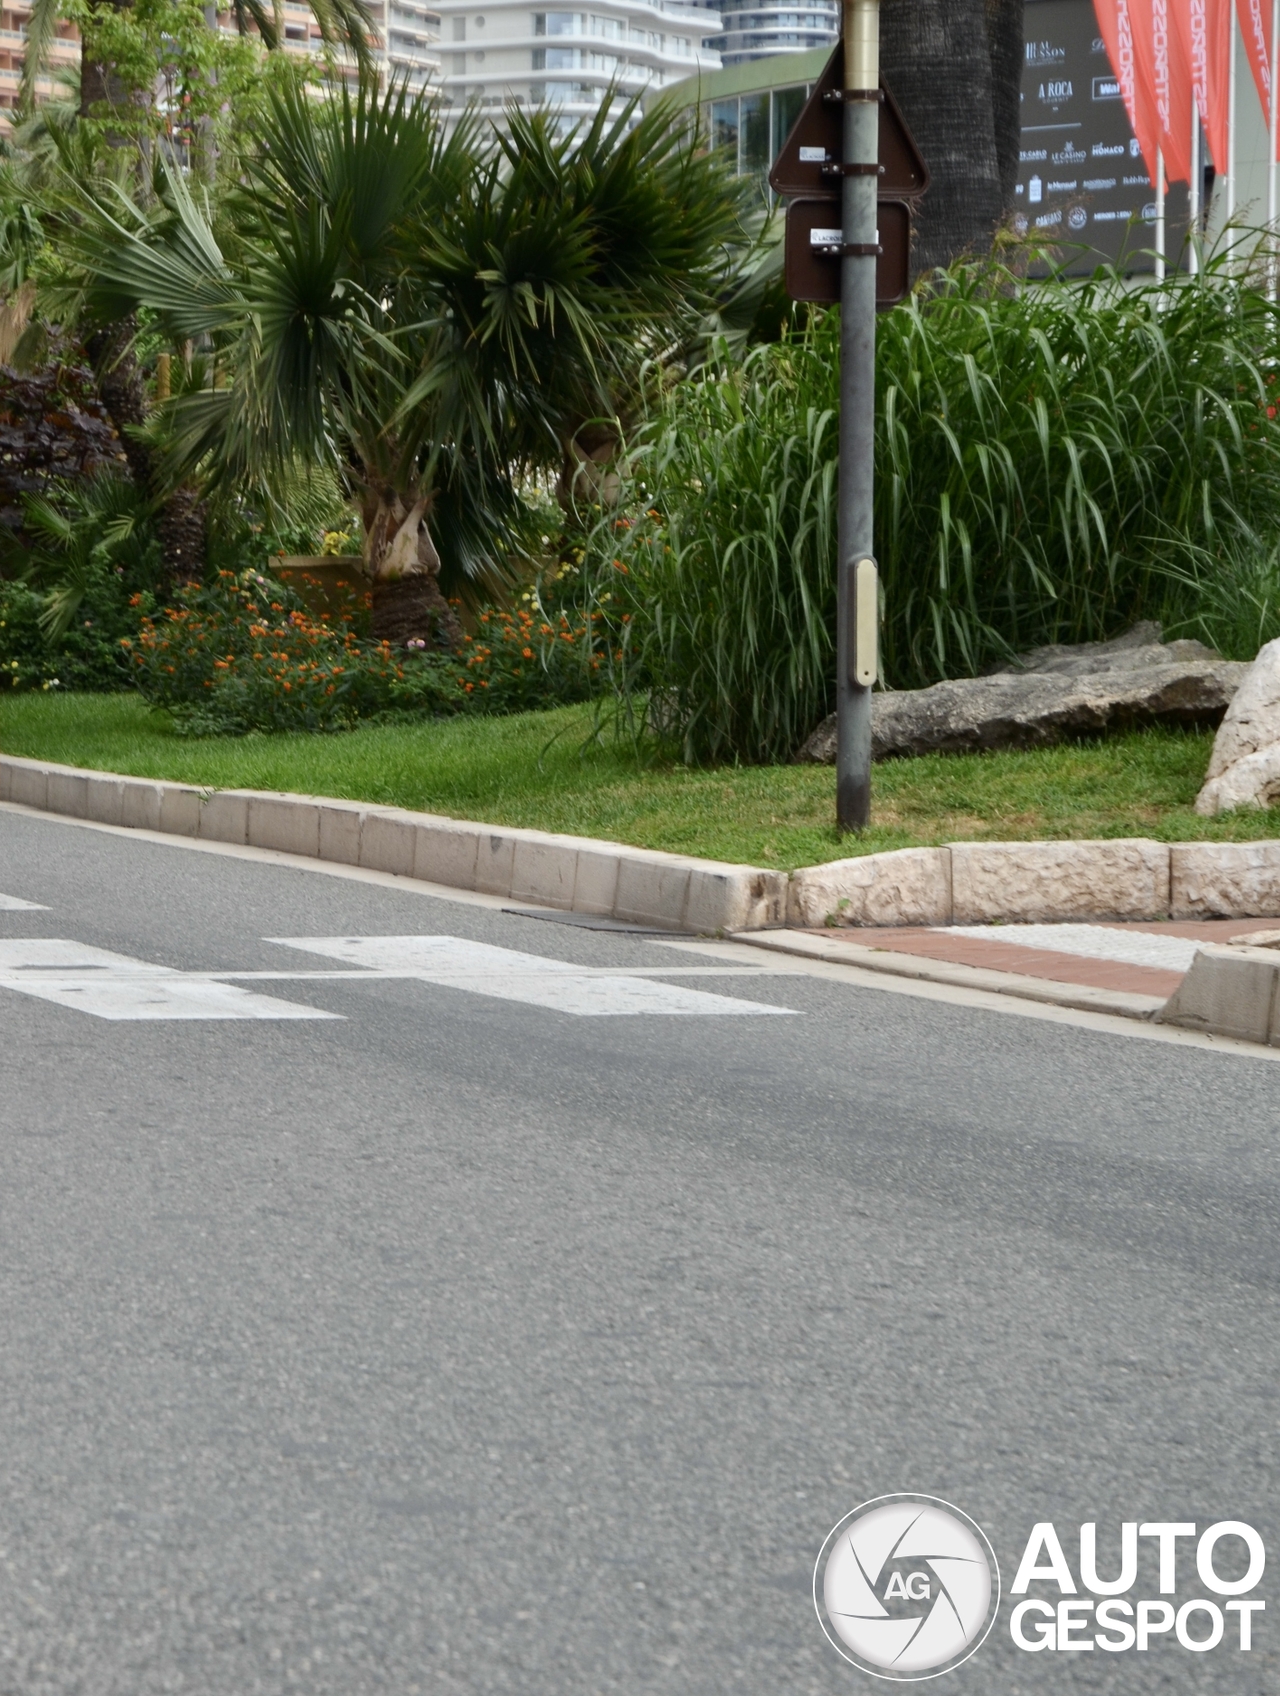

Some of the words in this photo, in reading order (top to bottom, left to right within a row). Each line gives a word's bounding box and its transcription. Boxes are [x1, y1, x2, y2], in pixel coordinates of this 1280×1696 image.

[1048, 80, 1074, 98] ROCA
[1059, 150, 1087, 160] CASINO
[1092, 146, 1125, 156] MONACO
